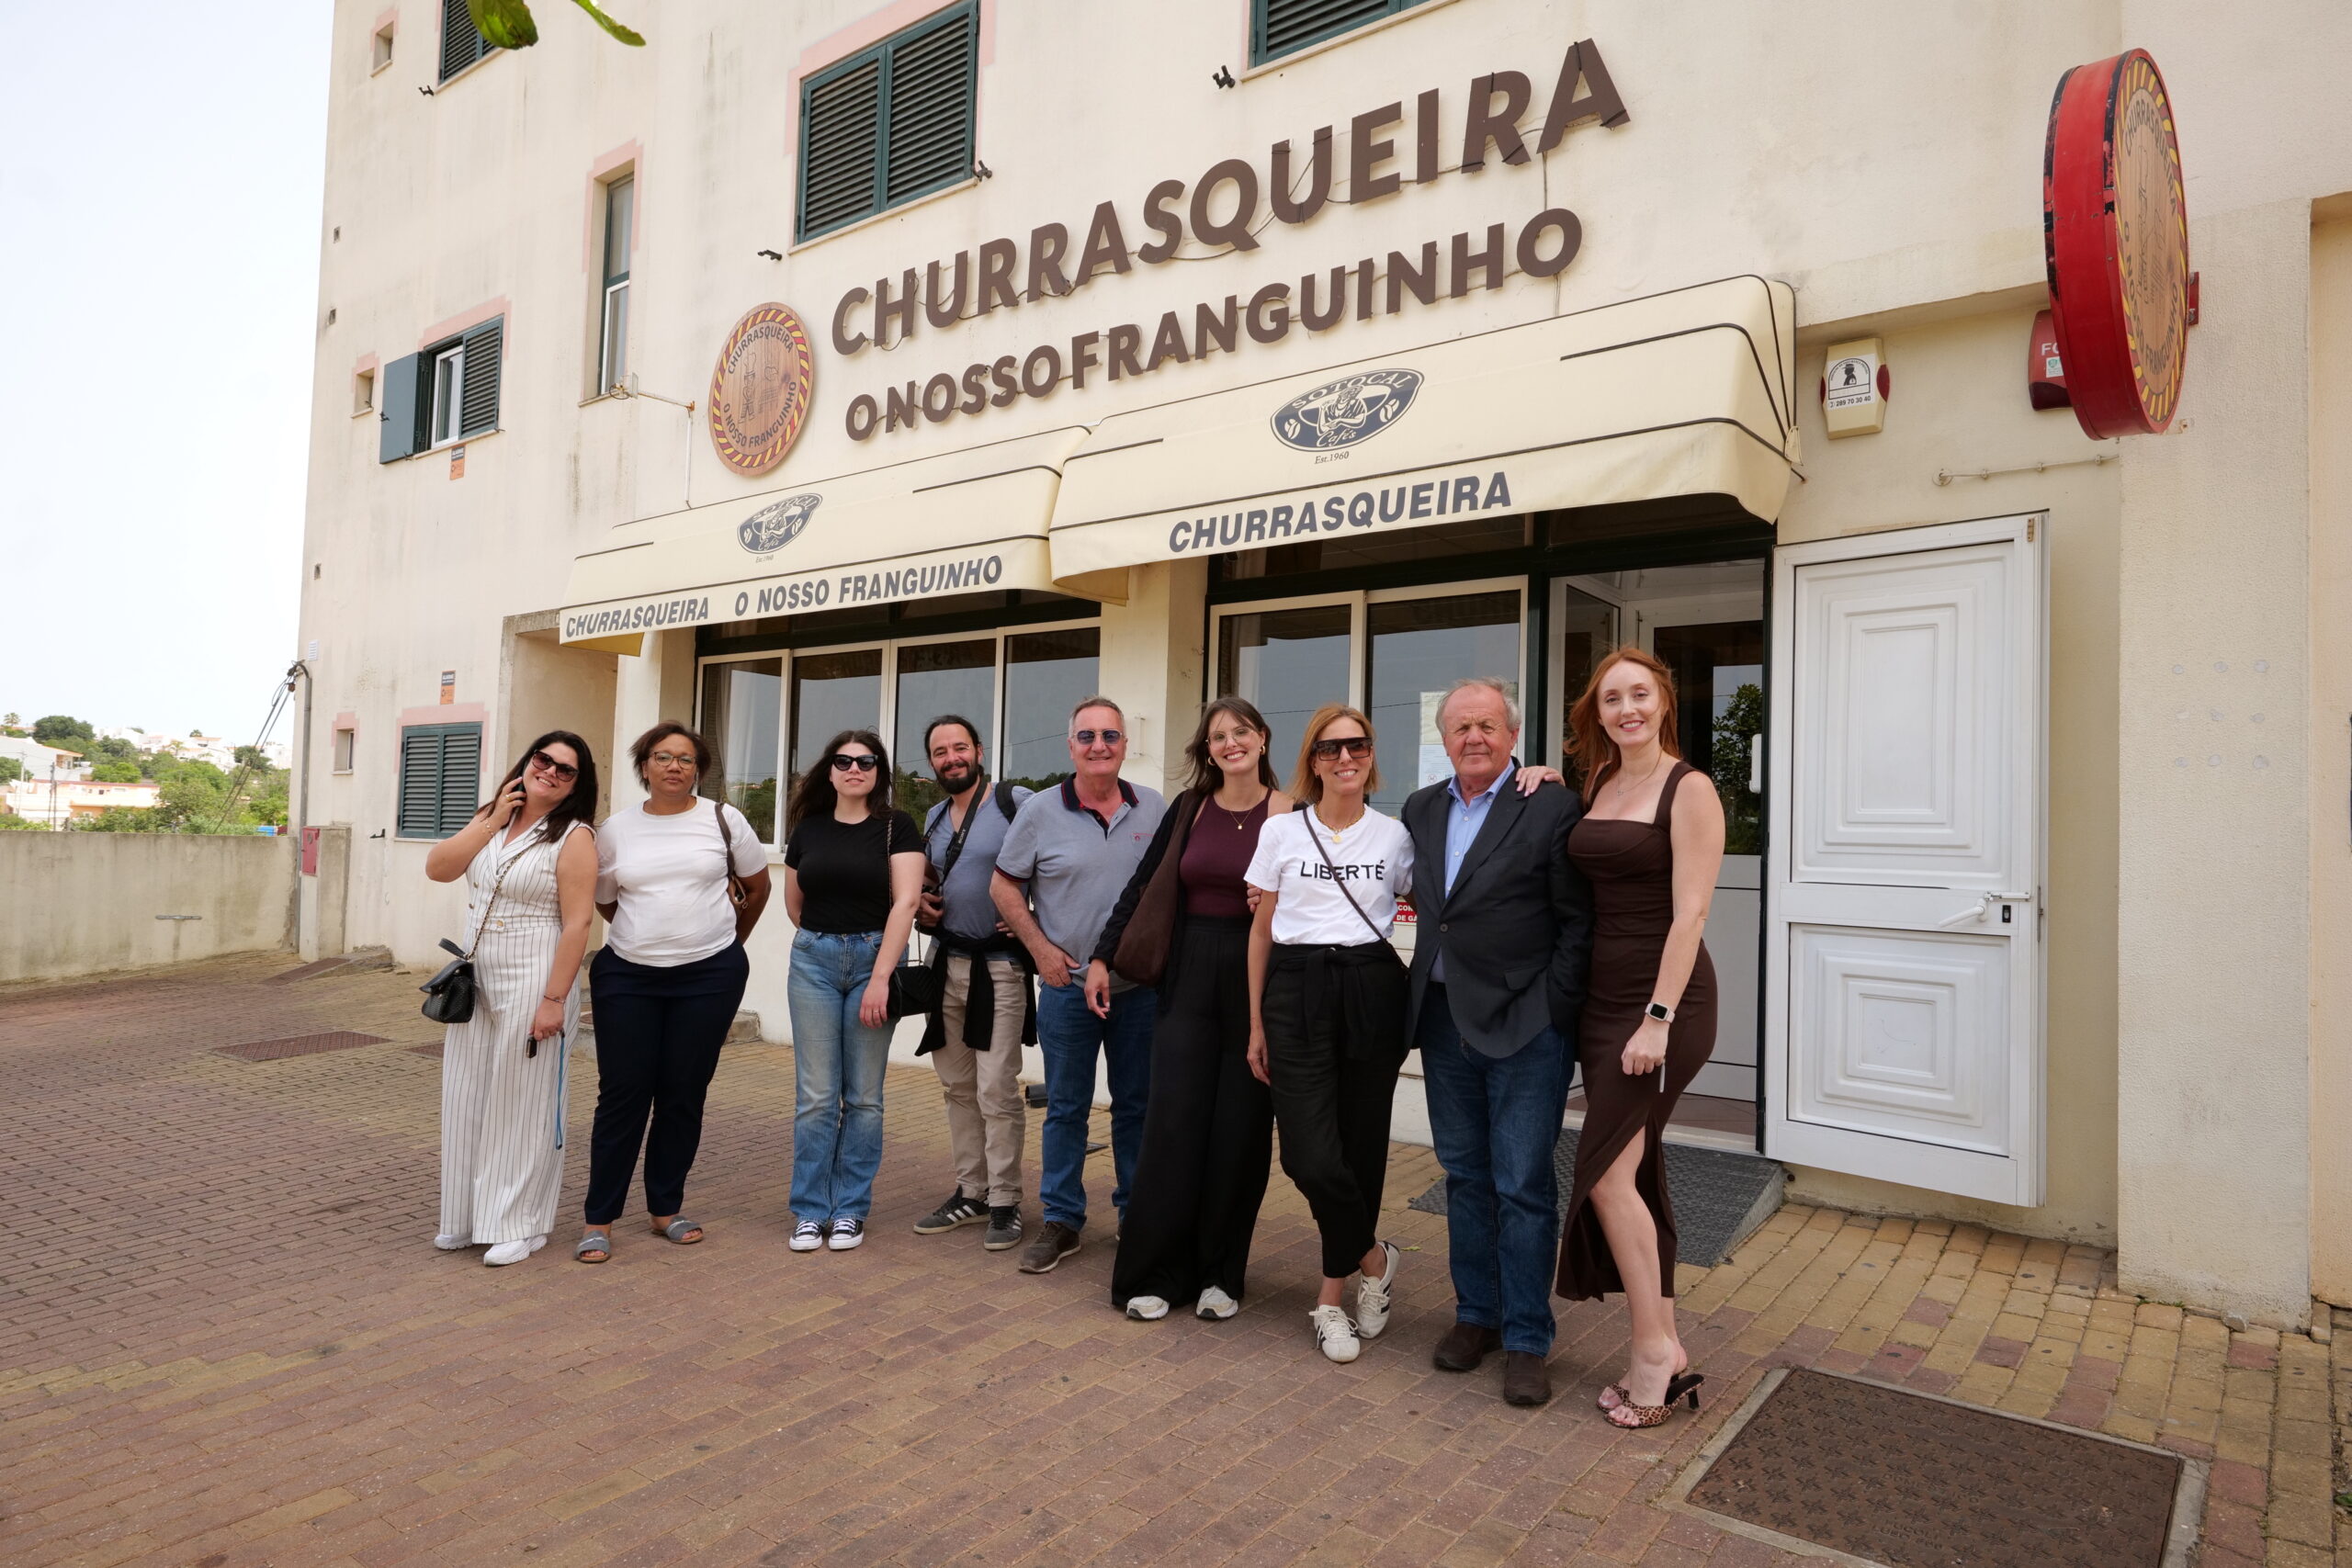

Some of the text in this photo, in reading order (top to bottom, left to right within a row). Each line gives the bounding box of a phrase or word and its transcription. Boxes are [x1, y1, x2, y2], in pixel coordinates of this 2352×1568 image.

[2124, 97, 2177, 217] CHURRASQUEIRA
[831, 37, 1632, 356] CHURRASQUEIRA
[2126, 254, 2145, 352] NOSSO
[2145, 284, 2178, 376] FRANGUINHO
[728, 325, 794, 375] CHURRASQUEIRA
[724, 381, 797, 448] O NOSSO FRANGUINHO
[1292, 373, 1412, 409] SOTOCAL
[1314, 451, 1350, 464] Est.1960
[1317, 427, 1357, 447] Cafés
[1169, 471, 1511, 553] CHURRASQUEIRA
[565, 555, 1002, 637] CHURRASQUEIRA O NOSSO FRANGUINHO
[1300, 860, 1385, 881] LIBERTÉ
